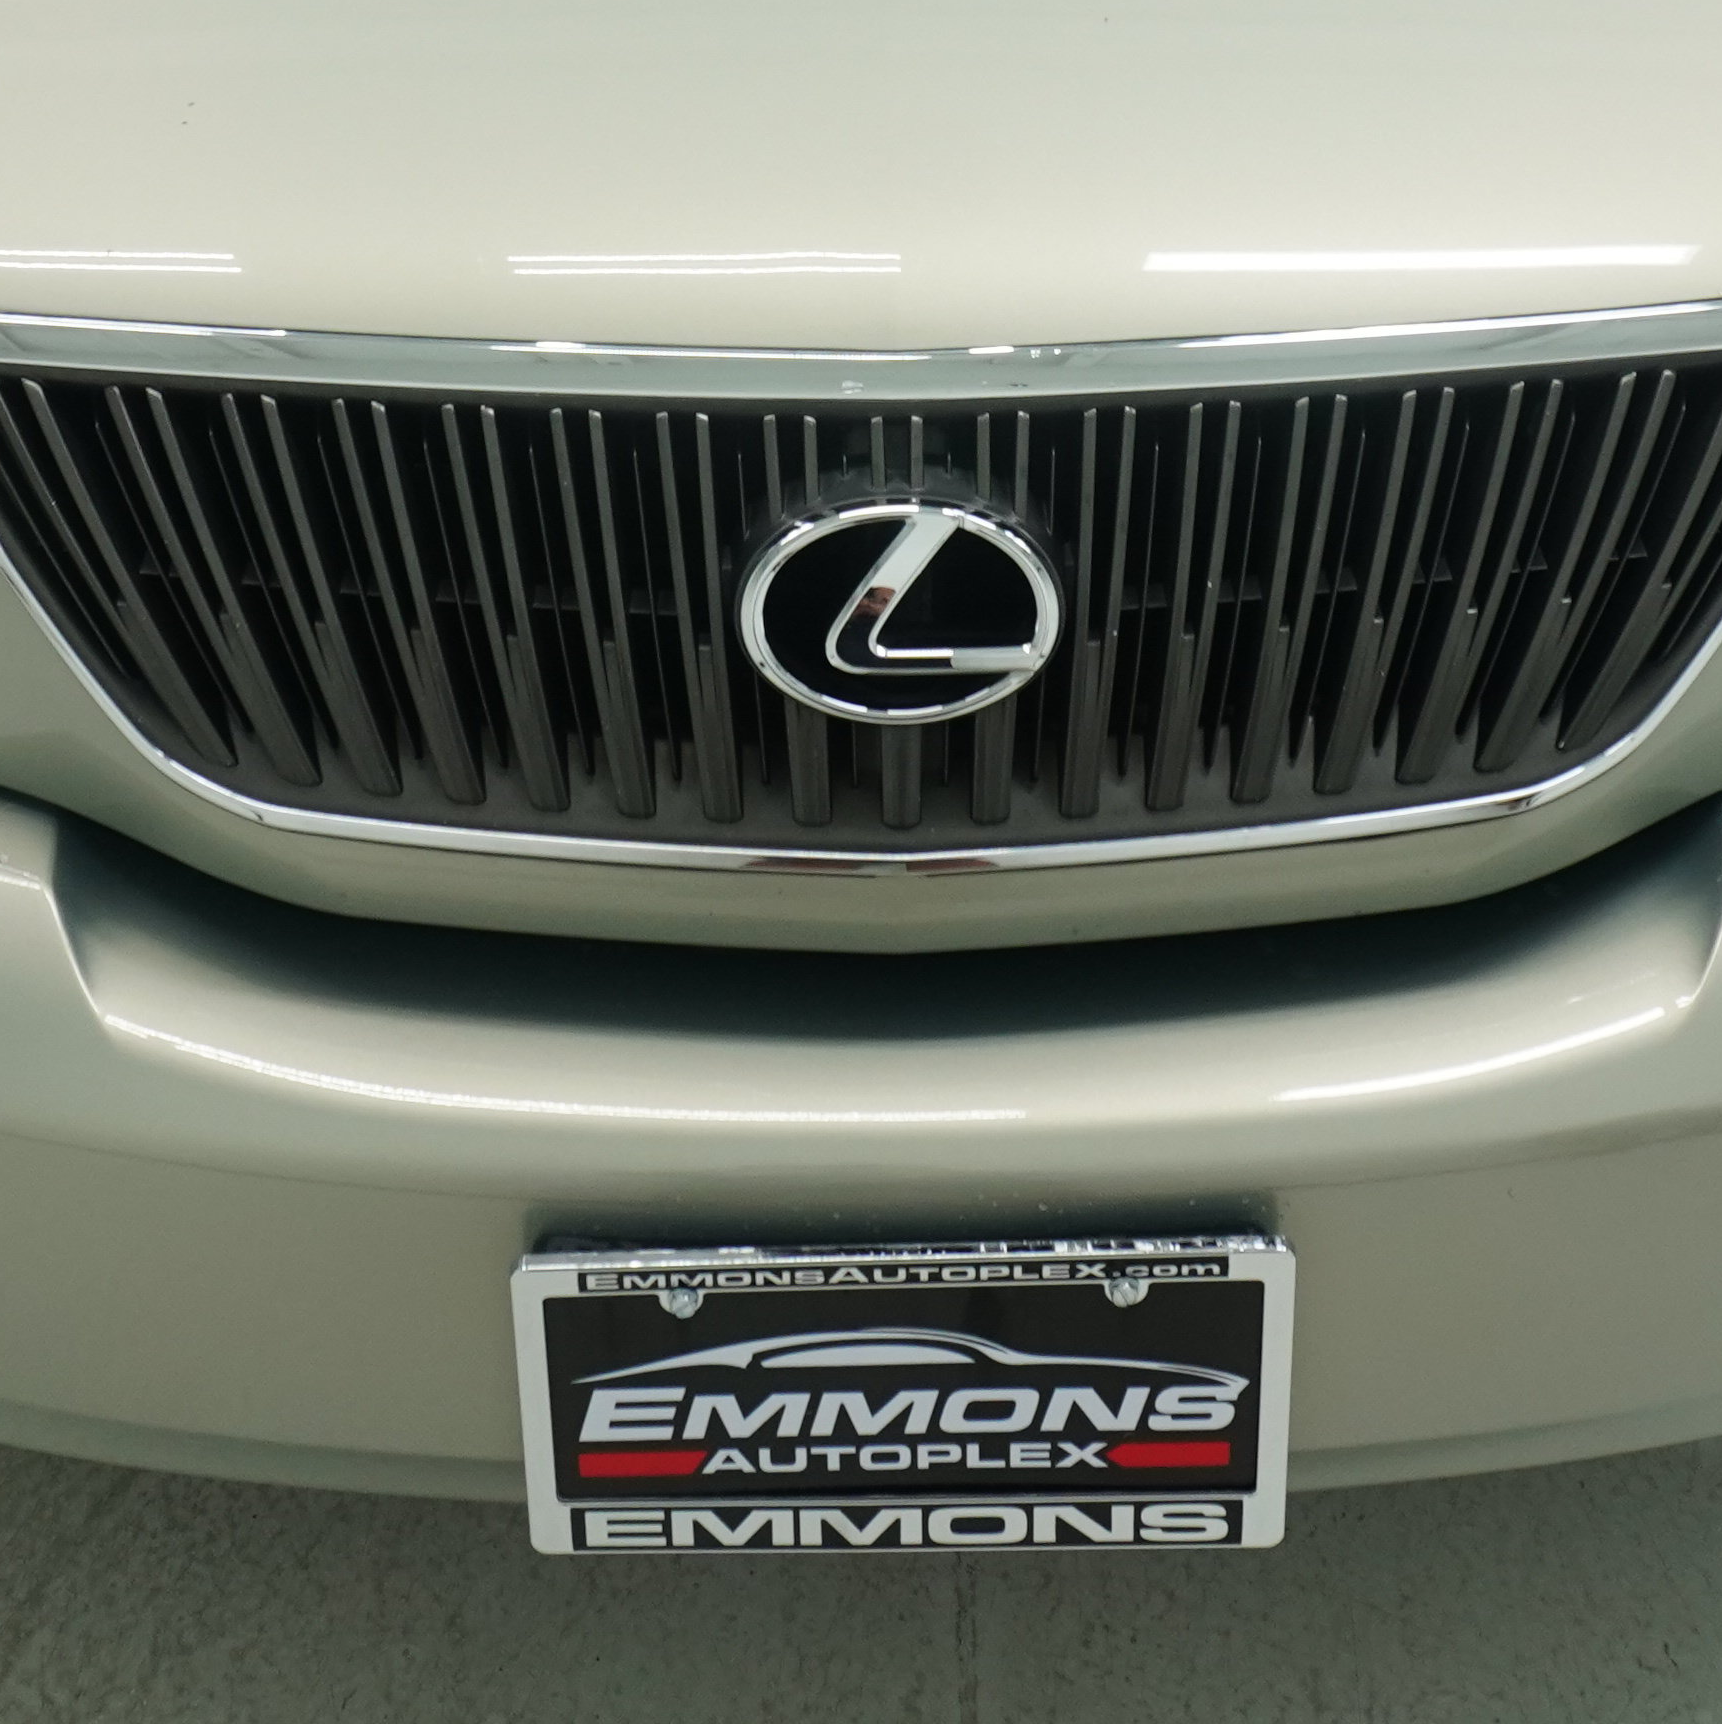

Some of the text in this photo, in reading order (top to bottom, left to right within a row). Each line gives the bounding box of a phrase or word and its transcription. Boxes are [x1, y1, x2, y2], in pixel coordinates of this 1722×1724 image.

[578, 1385, 1237, 1443] EMMONS
[701, 1441, 1109, 1475] AUTOPLEX
[584, 1502, 1230, 1548] EMMONS
